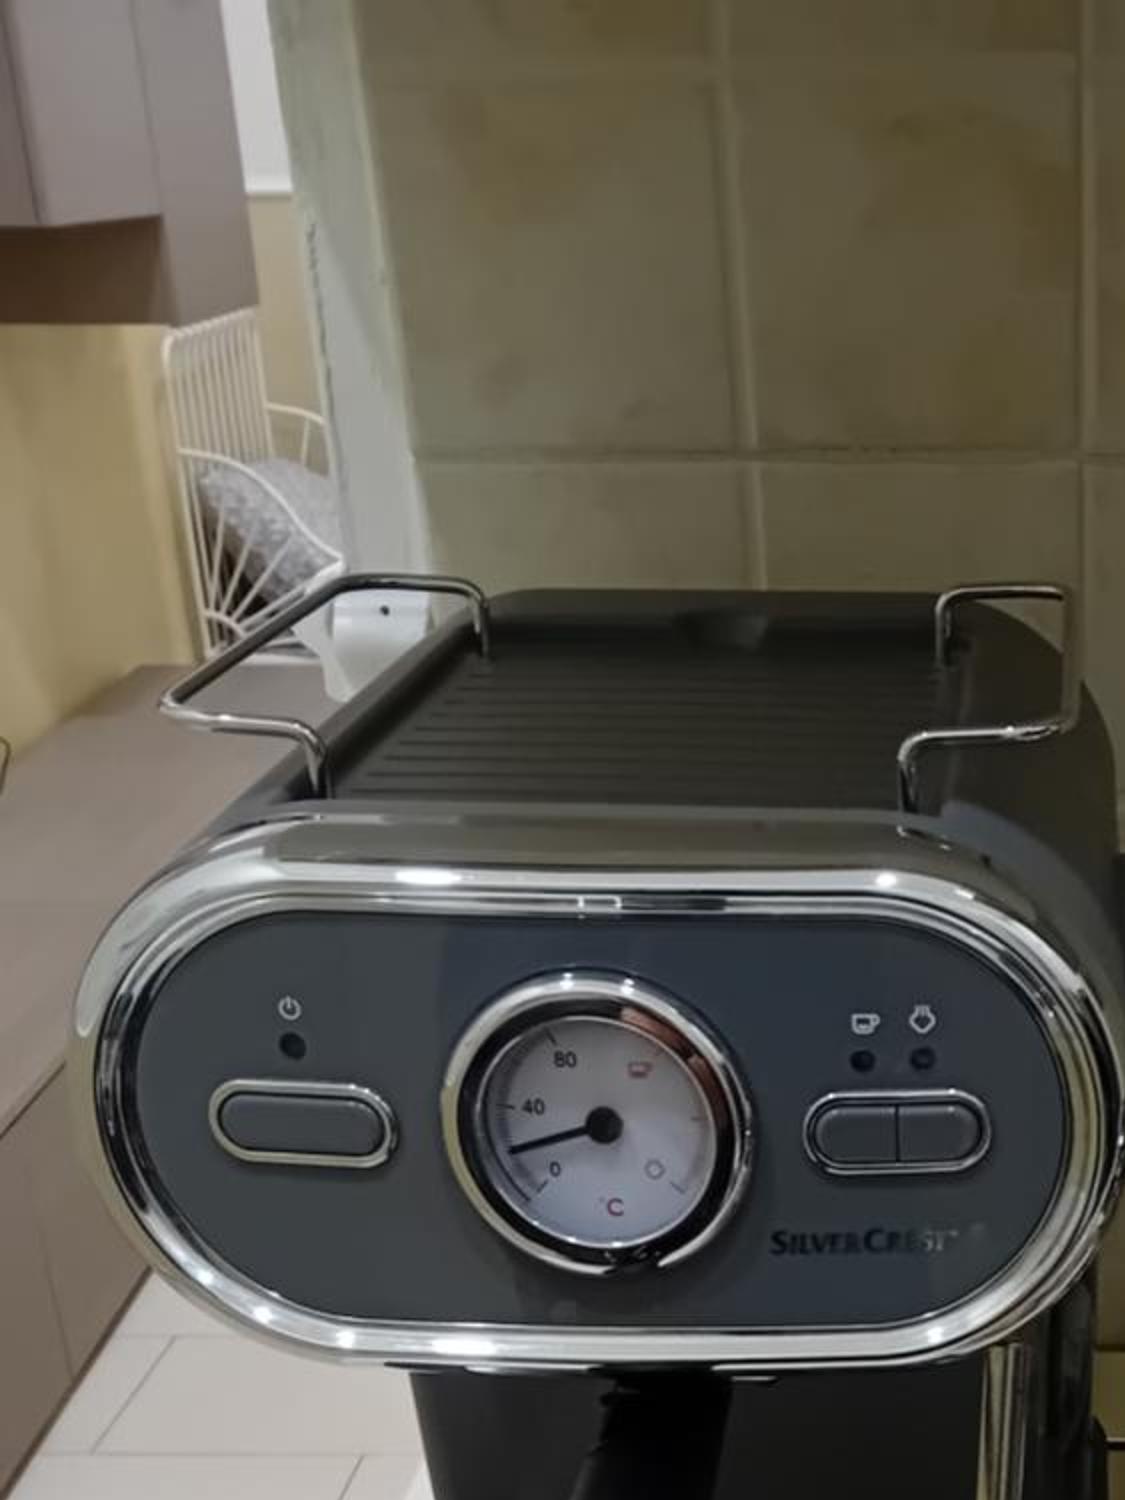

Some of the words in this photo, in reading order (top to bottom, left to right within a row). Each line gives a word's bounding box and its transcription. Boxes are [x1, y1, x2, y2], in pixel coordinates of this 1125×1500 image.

[554, 1051, 578, 1068] 80
[521, 1098, 545, 1116] 40
[549, 1161, 562, 1177] 0
